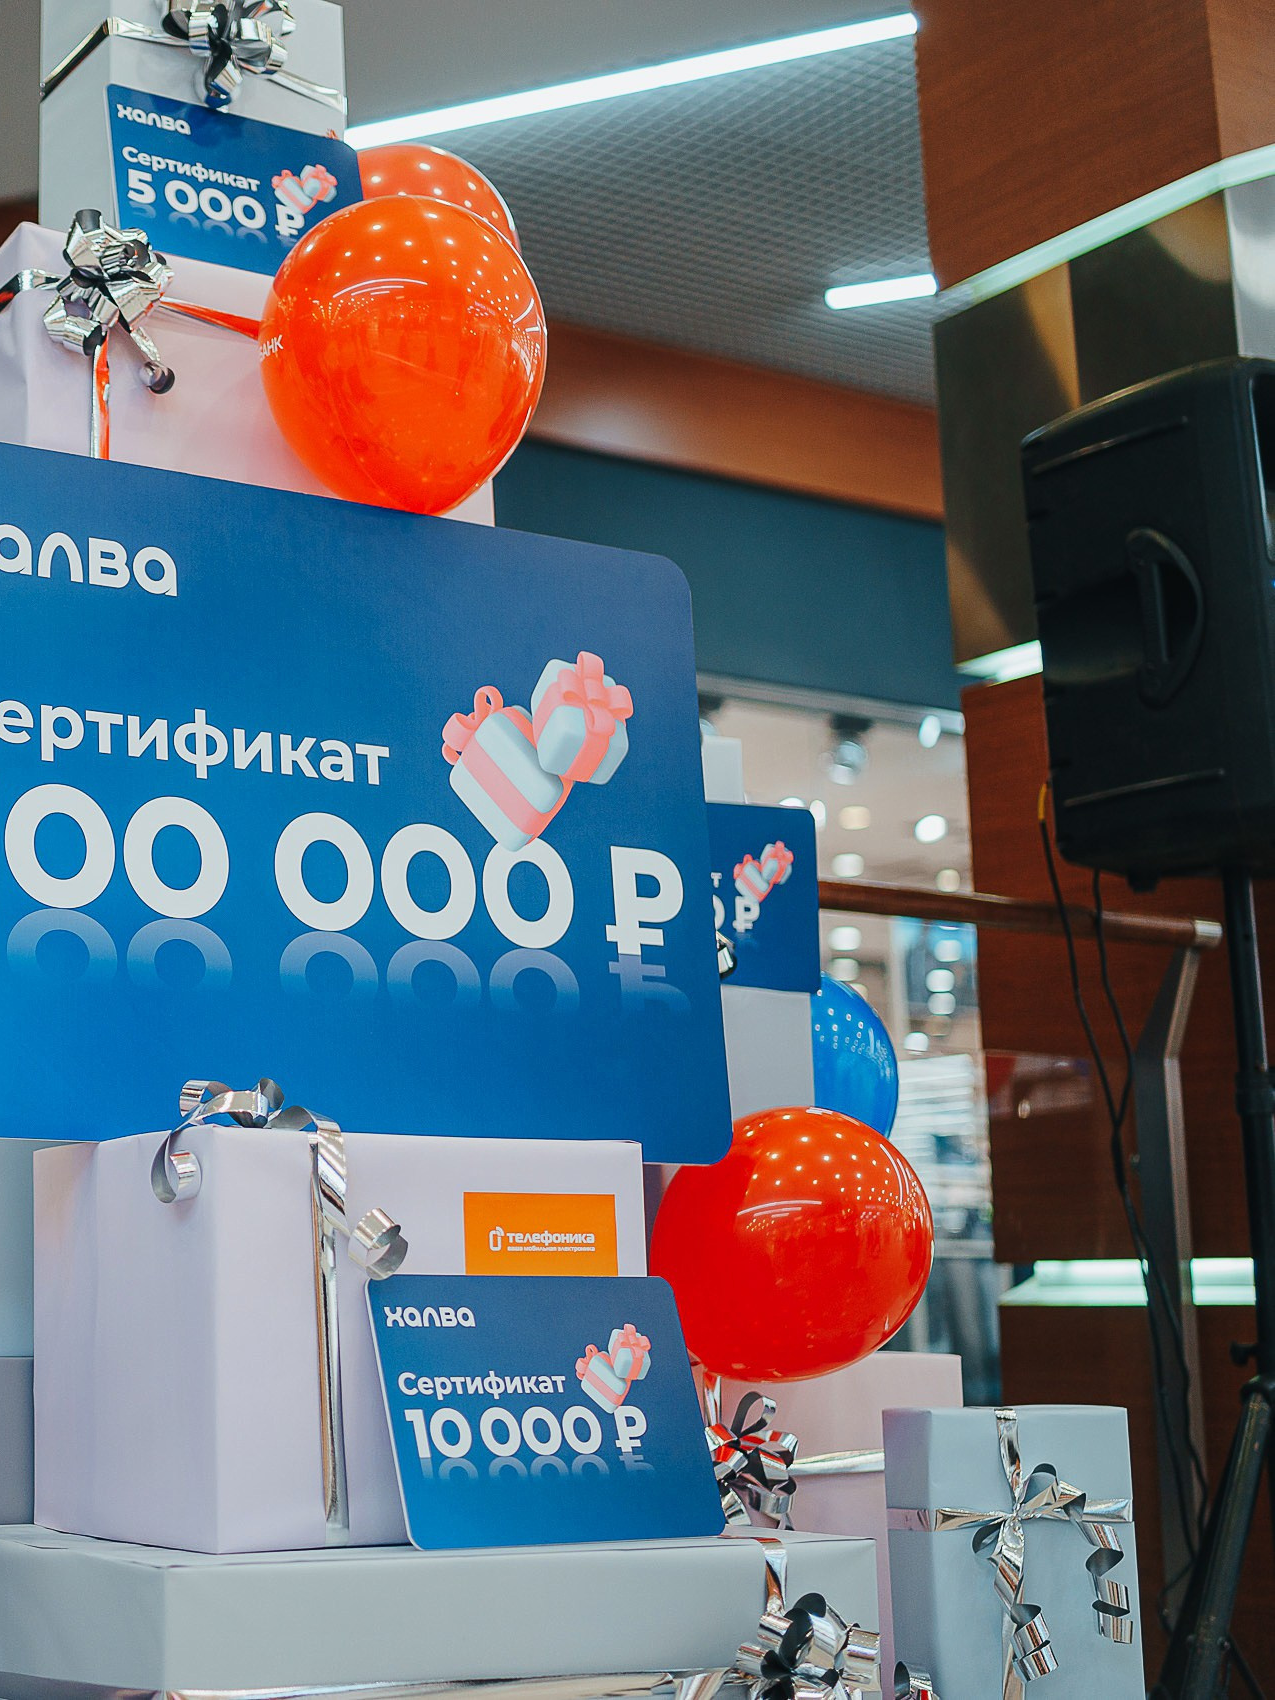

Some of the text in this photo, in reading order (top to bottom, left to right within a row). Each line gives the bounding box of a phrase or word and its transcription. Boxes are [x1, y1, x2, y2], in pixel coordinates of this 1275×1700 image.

[122, 146, 261, 192] Сертификат
[274, 812, 574, 949] 000
[506, 1230, 596, 1246] телефоника
[397, 1370, 566, 1401] Сертификат
